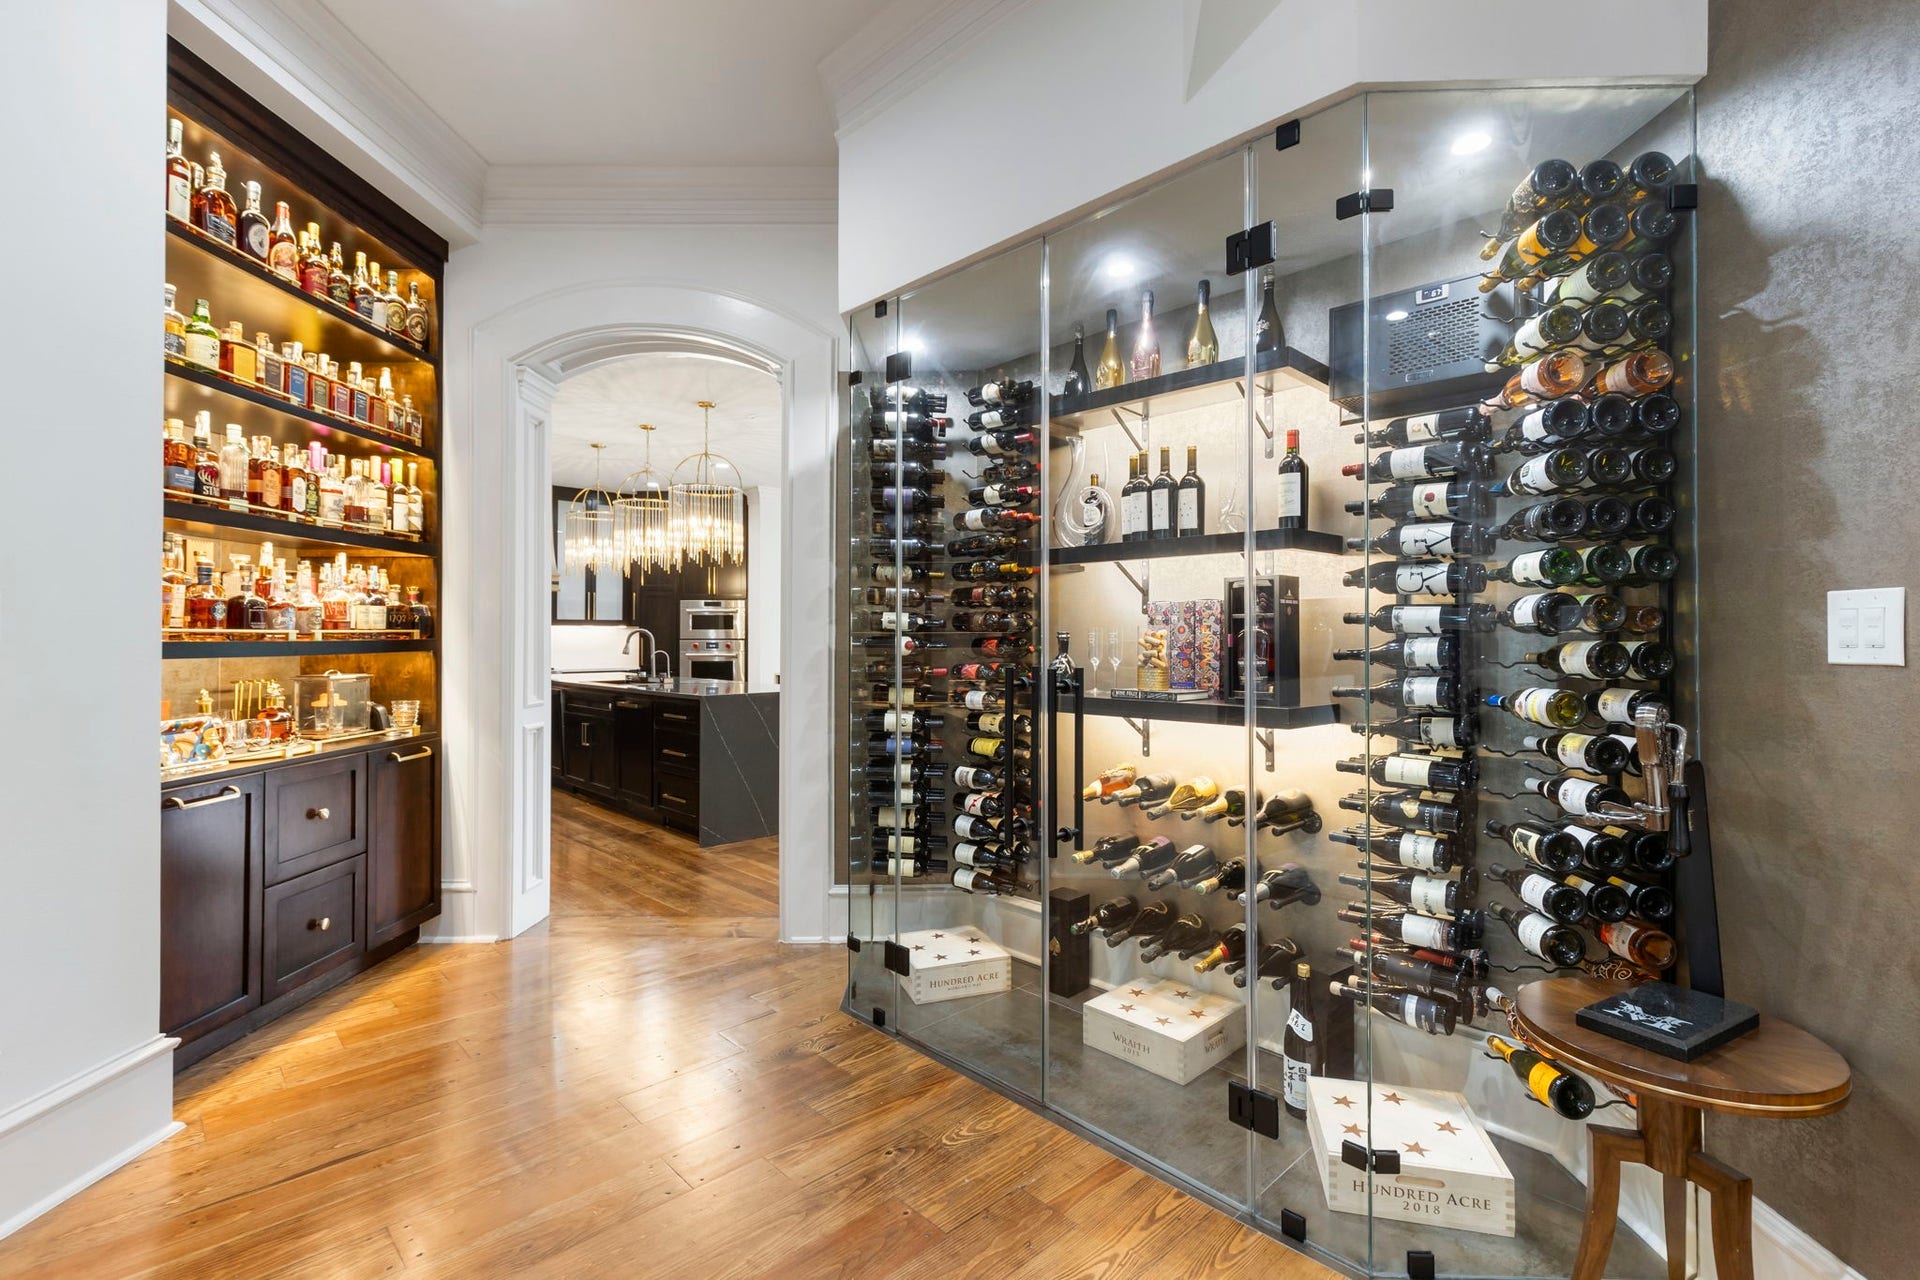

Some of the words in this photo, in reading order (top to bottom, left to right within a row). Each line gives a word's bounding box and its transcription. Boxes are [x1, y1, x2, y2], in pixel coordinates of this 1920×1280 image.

[930, 976, 974, 989] HUNDRED
[978, 972, 999, 982] ACRE
[1112, 1031, 1151, 1054] WRAITH
[1402, 1200, 1441, 1215] 2018
[1446, 1193, 1492, 1211] ACRE
